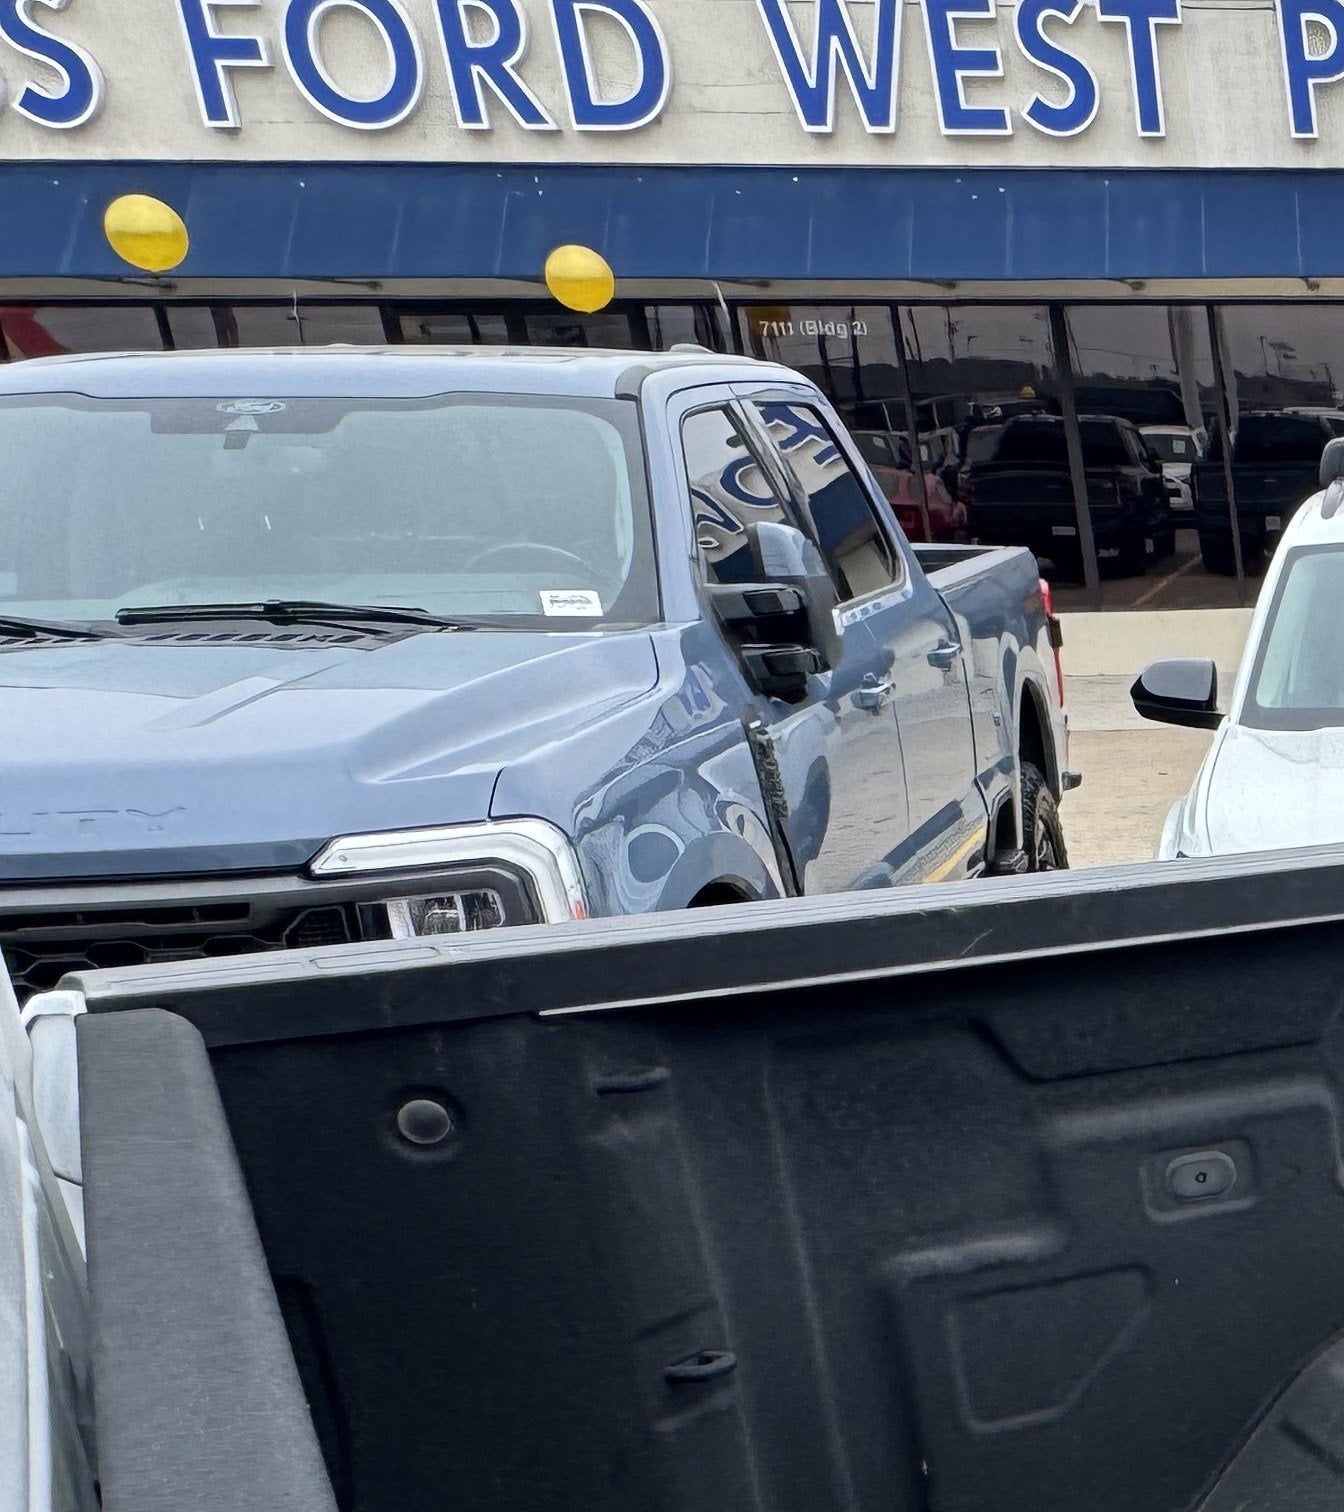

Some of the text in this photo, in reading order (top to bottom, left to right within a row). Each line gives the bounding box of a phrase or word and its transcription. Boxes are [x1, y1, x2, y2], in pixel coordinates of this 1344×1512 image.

[174, 0, 673, 132] FORD
[754, 0, 1183, 138] WEST
[759, 320, 794, 336] 7111
[800, 320, 848, 339] (Bldg
